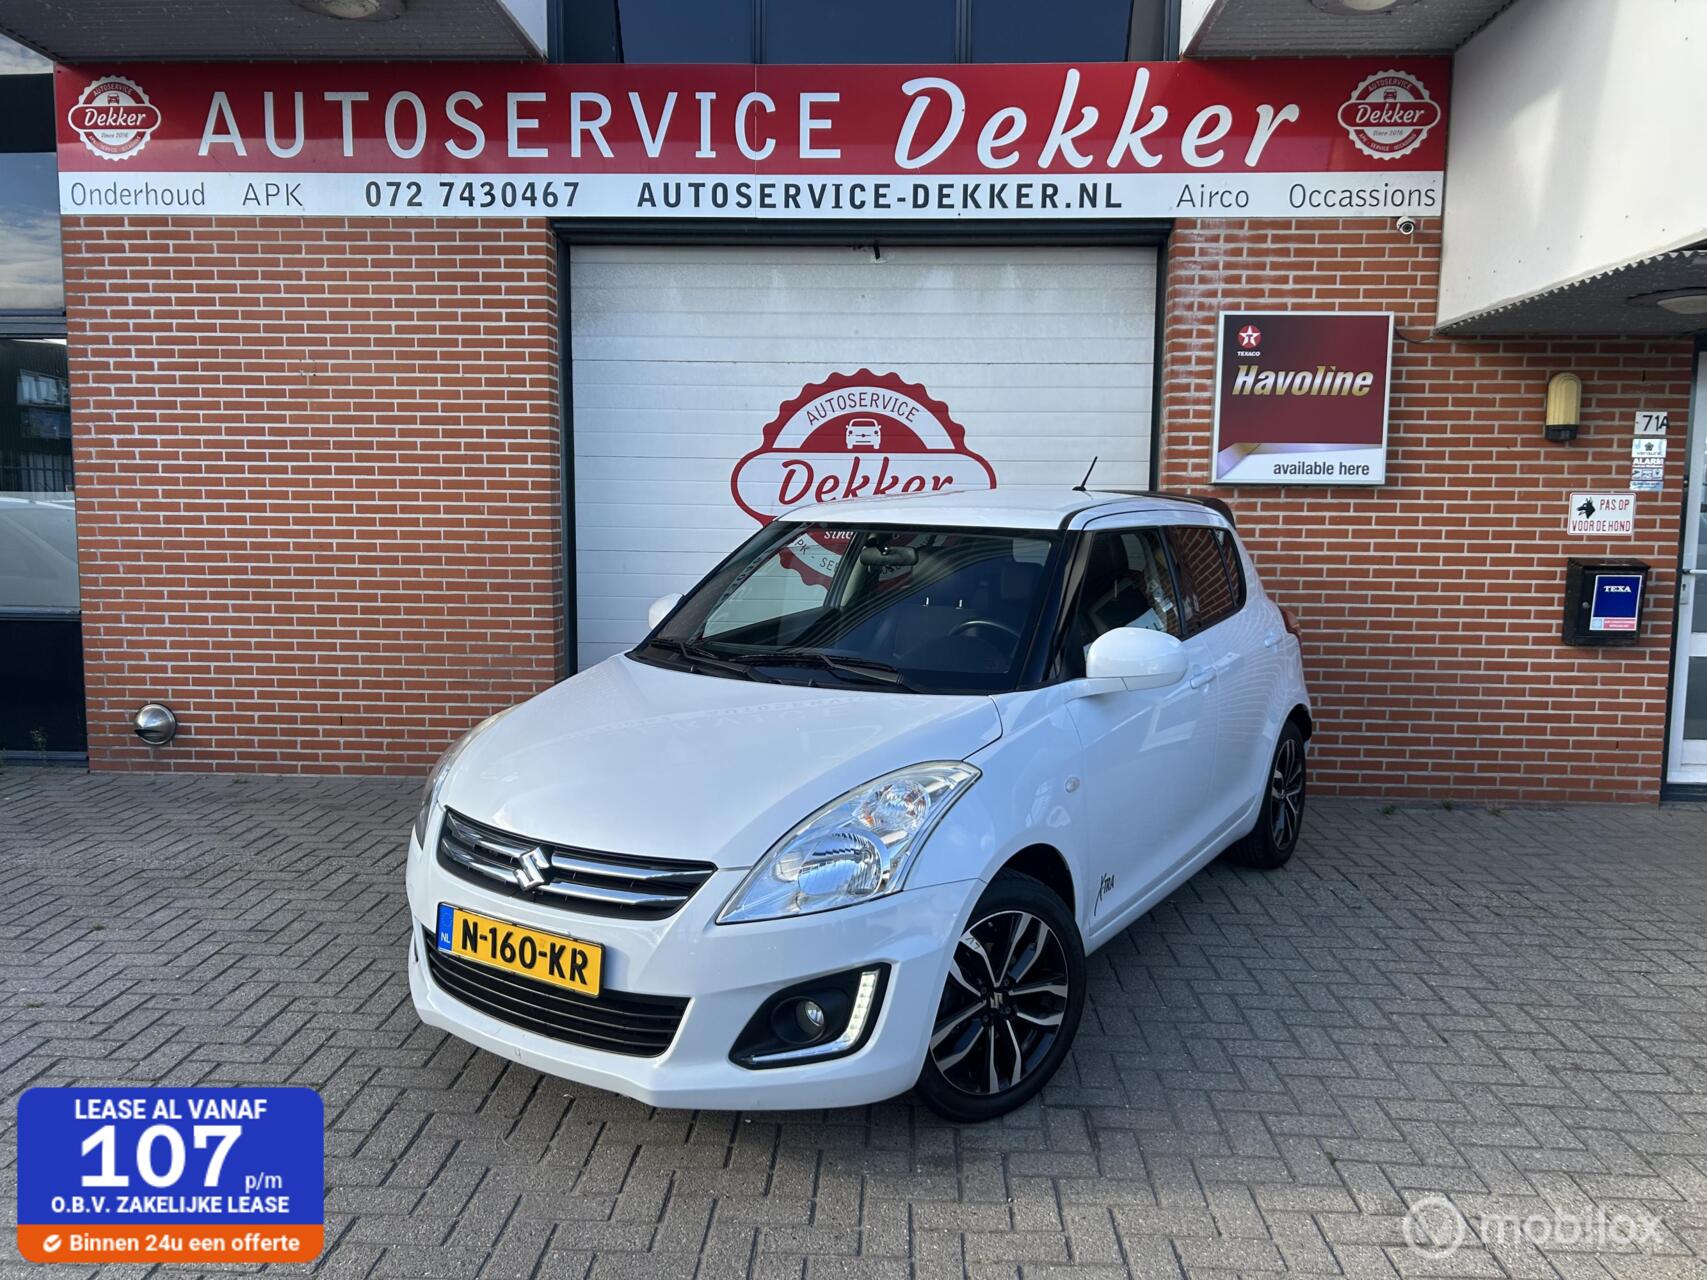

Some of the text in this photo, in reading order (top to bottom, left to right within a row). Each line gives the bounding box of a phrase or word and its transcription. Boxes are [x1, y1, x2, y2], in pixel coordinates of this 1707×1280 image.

[93, 84, 132, 95] AUTOSERVICE
[1368, 78, 1412, 91] AUTOSERVICE
[84, 107, 146, 126] Dekker
[198, 67, 1300, 171] AUTOSERVICE Dekker
[1356, 103, 1424, 123] Dekker
[70, 181, 303, 207] Onderhoud APK
[365, 181, 580, 208] 072 7430467
[636, 182, 1123, 209] AUTOSERVICE-DEKKER.NL
[1176, 182, 1437, 209] Airco Occassions
[1232, 364, 1374, 396] Havoline
[806, 392, 920, 426] AUTOSERVICE
[1642, 414, 1670, 432] 71A
[1273, 461, 1370, 476] available here
[1633, 457, 1664, 466] ALARM
[1600, 499, 1630, 511] PAS OP
[1572, 520, 1631, 532] VOOR DE HOND
[1603, 585, 1632, 593] TEXA
[440, 918, 588, 985] NL N-160-KR
